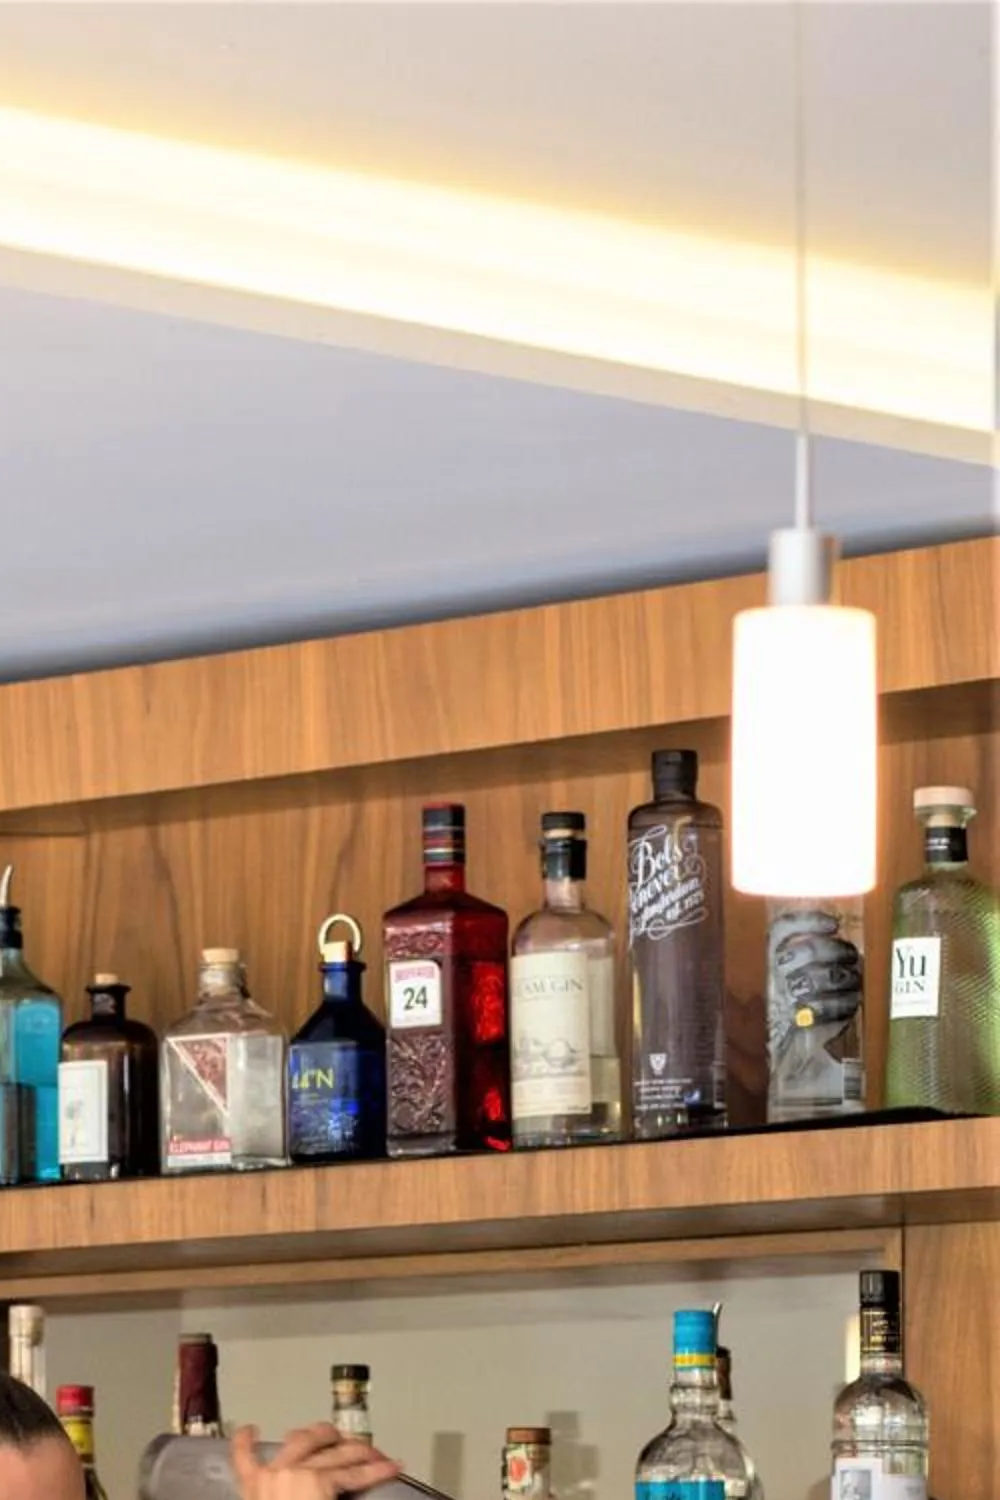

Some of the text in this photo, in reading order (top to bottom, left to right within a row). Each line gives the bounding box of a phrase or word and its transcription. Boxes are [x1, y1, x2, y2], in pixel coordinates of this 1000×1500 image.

[632, 817, 692, 888] Bols
[896, 948, 926, 978] Yu
[403, 986, 428, 1010] 24
